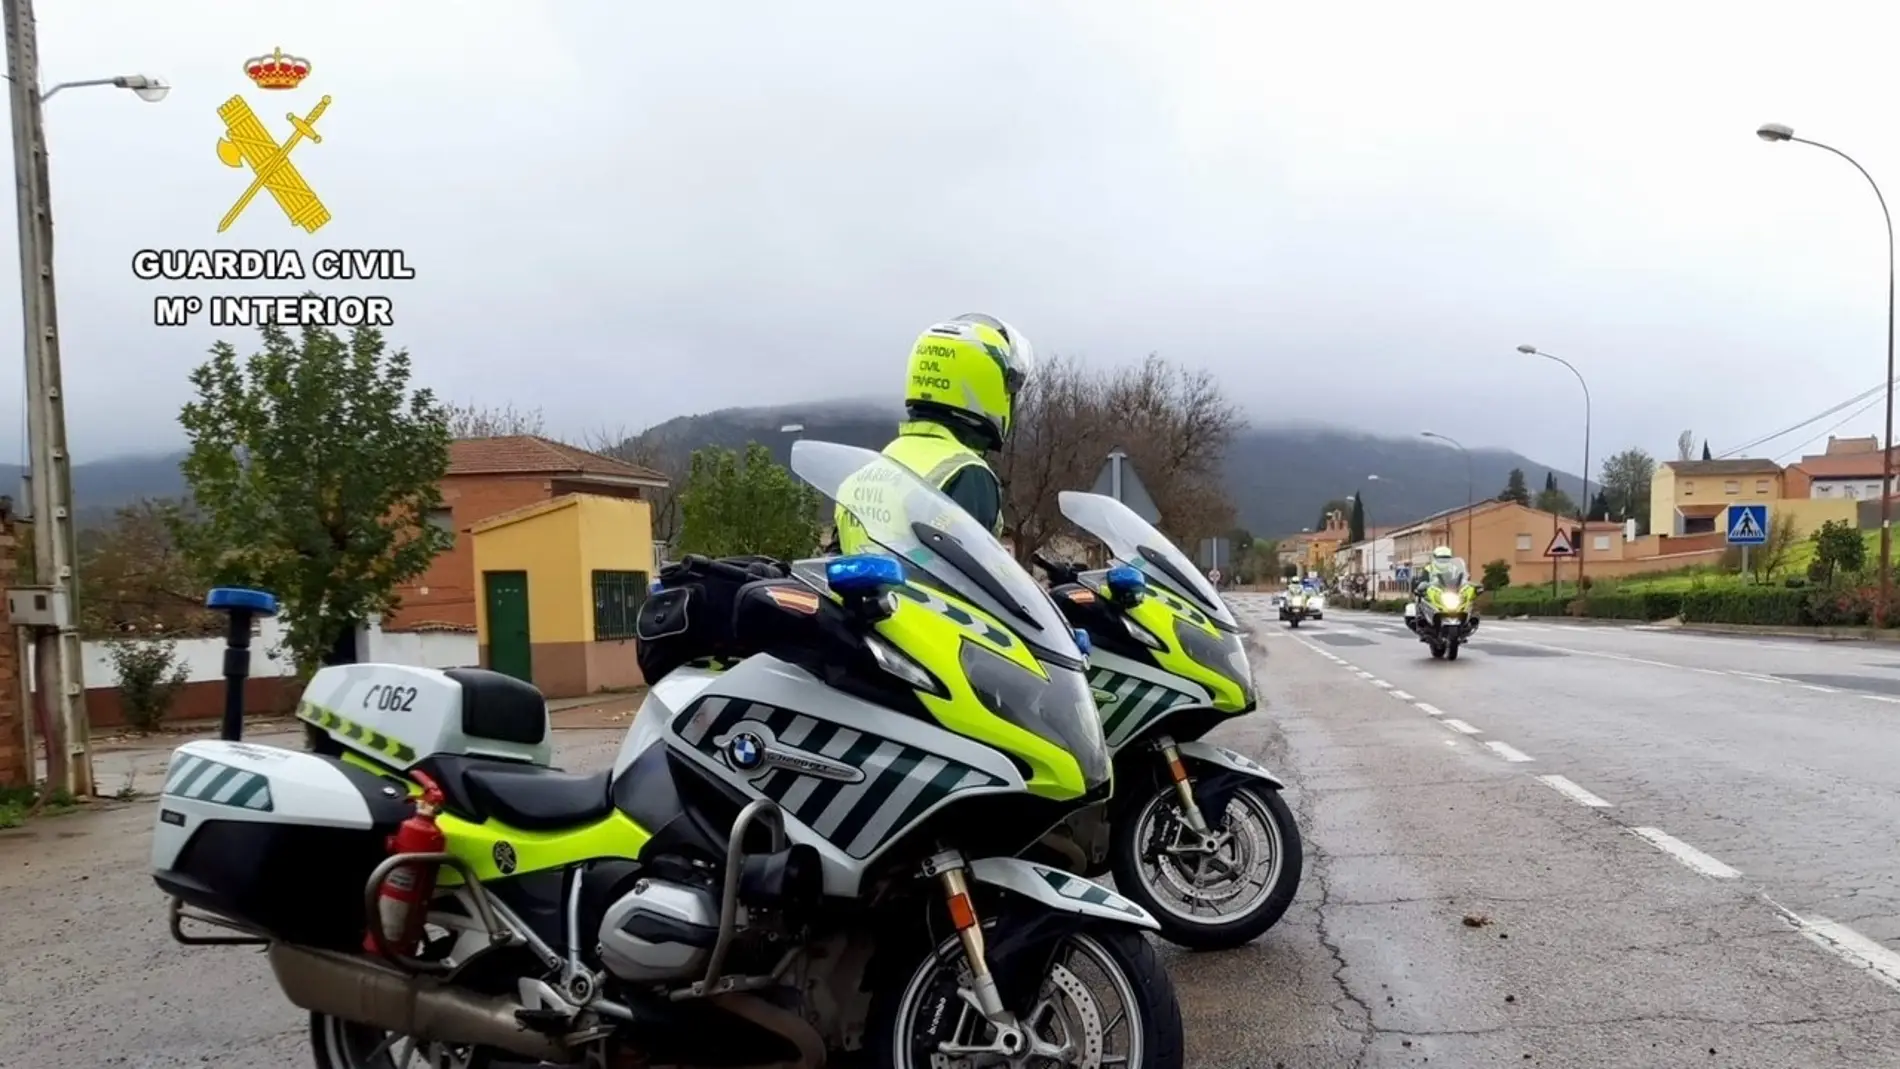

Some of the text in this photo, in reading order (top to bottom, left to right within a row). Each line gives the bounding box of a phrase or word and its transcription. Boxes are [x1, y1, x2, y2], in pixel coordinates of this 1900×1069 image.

[919, 360, 941, 373] CIVIL
[853, 487, 884, 504] CIVIL
[378, 685, 418, 712] 062
